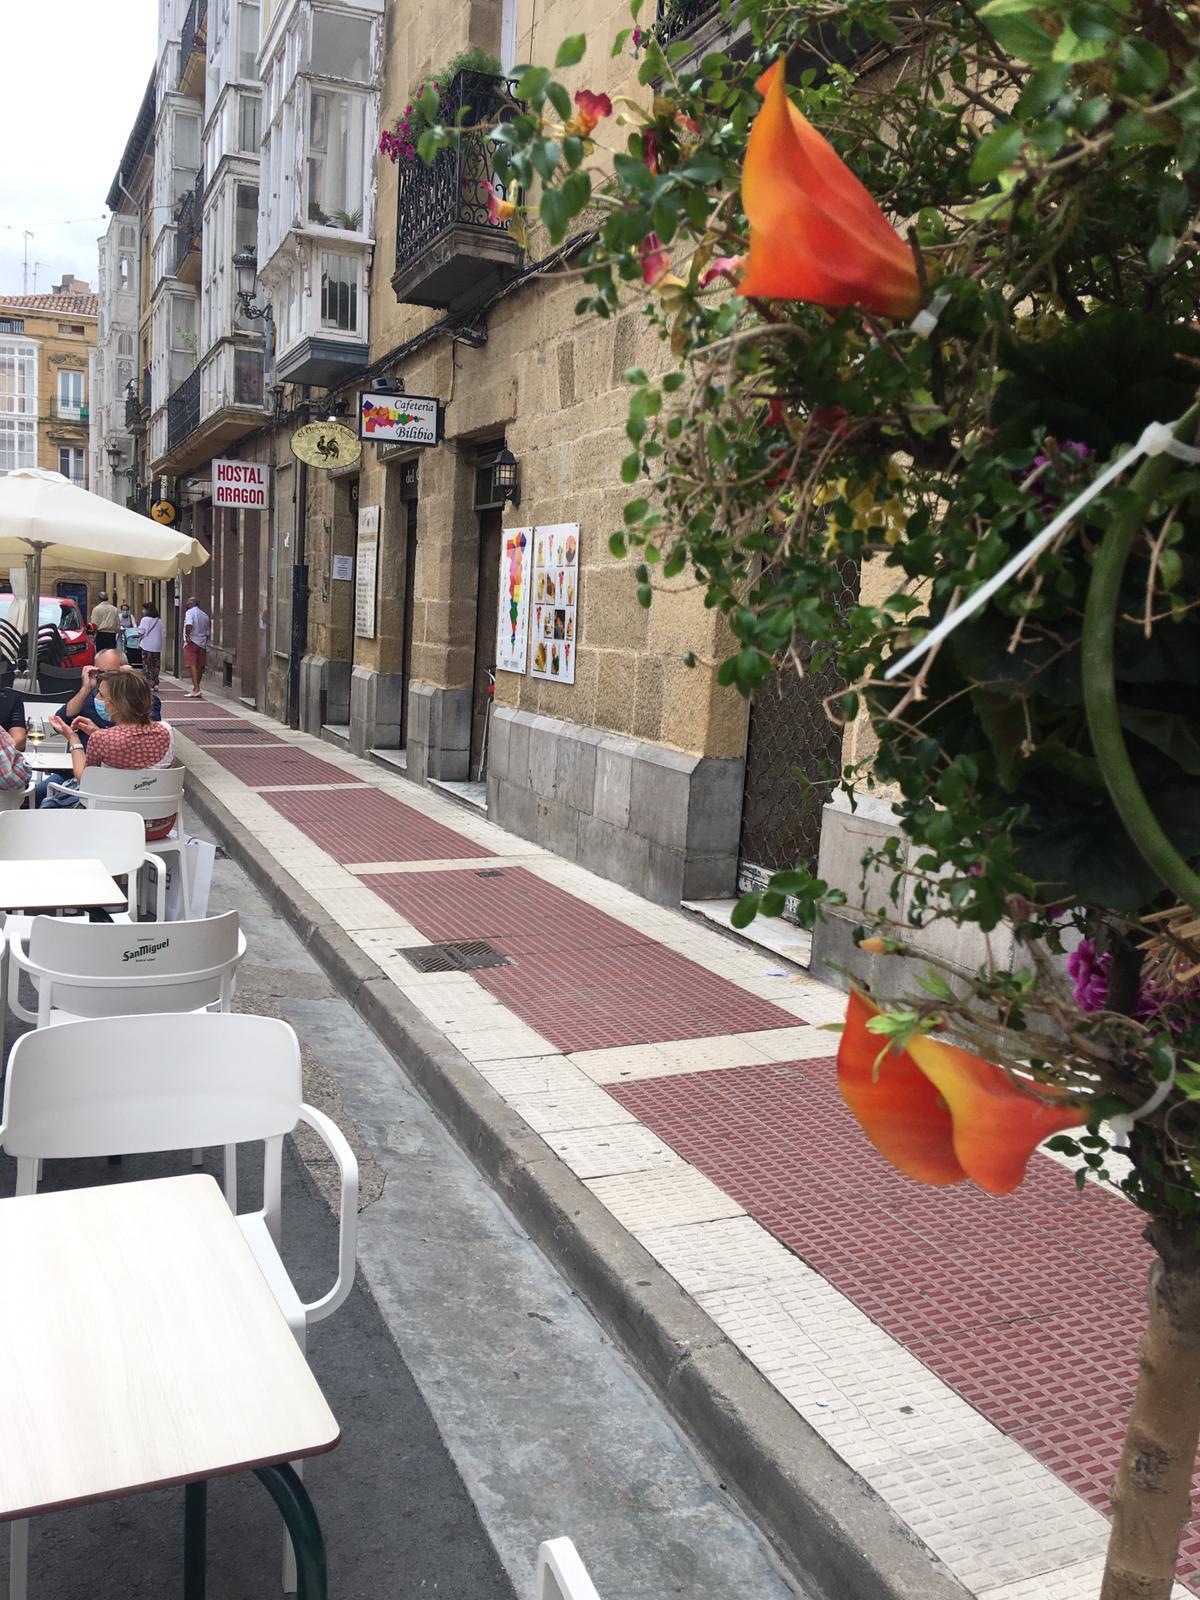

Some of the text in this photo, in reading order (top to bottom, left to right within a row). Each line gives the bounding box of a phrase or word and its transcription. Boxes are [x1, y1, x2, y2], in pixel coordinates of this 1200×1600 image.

[395, 426, 434, 441] Bilibio
[217, 464, 264, 485] HOSTAL
[217, 486, 264, 505] ARAGON
